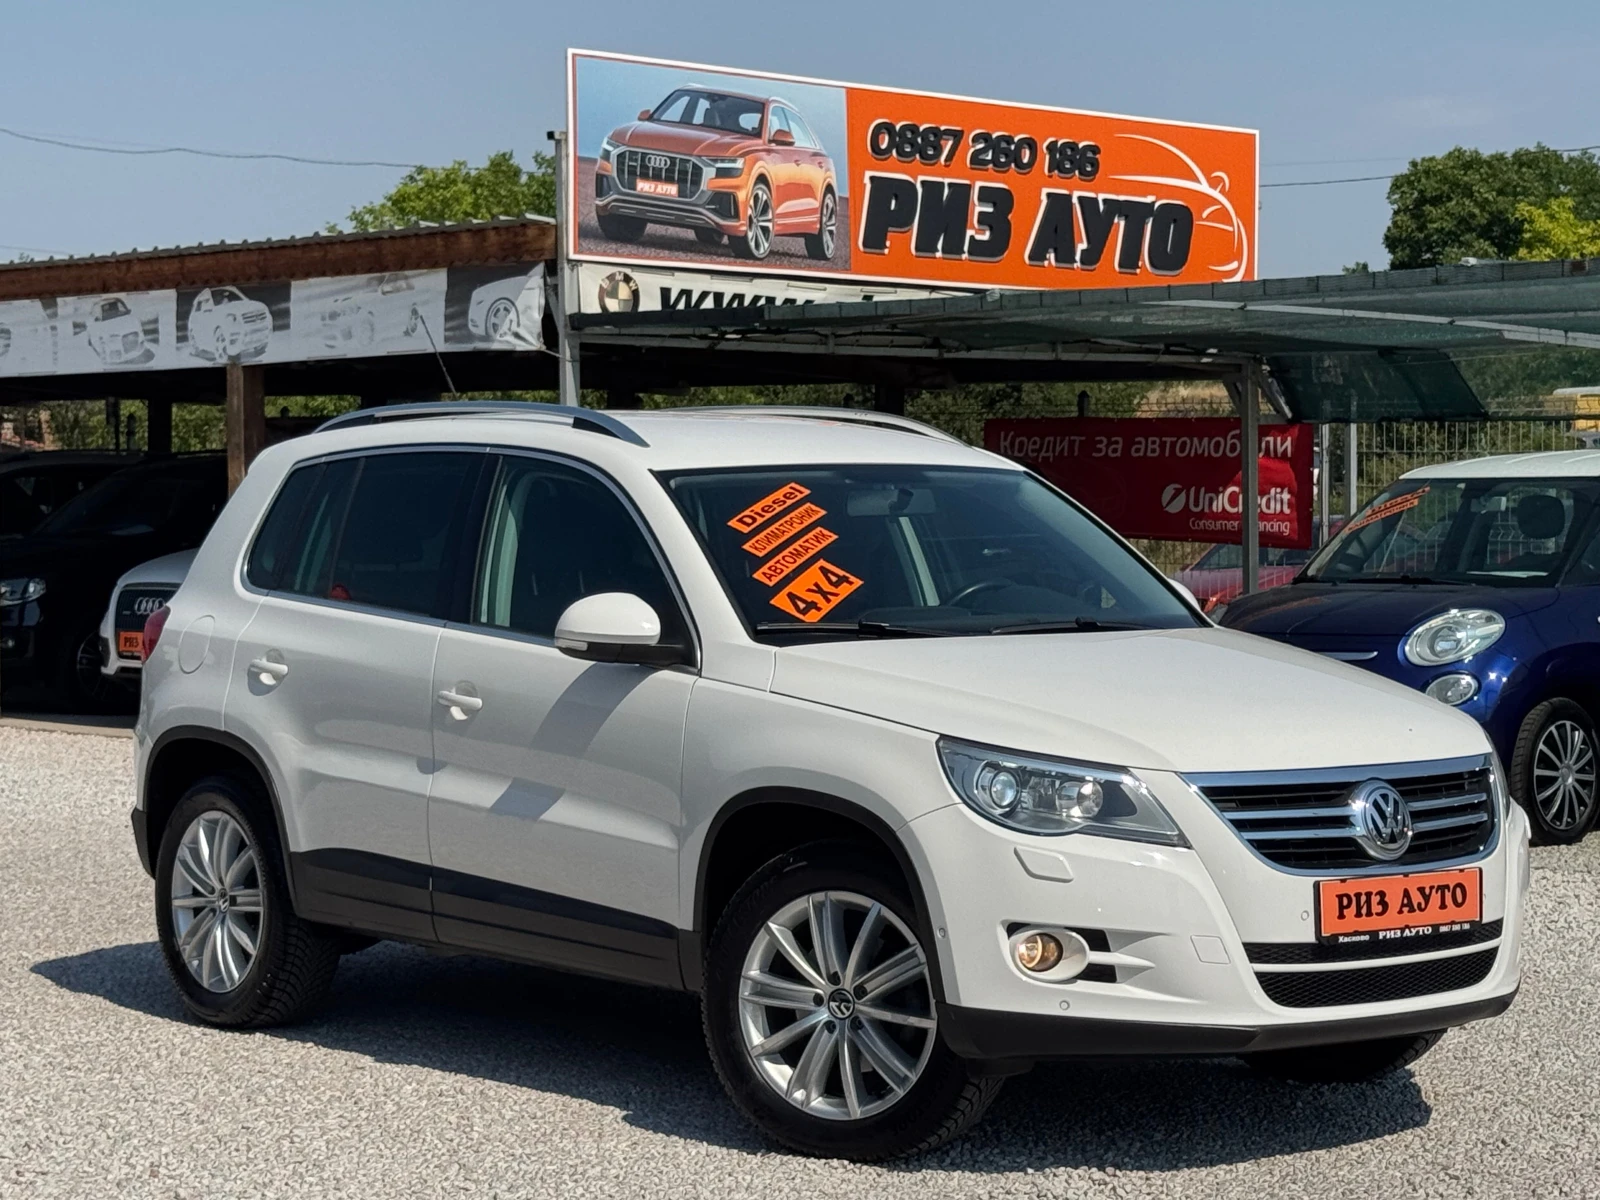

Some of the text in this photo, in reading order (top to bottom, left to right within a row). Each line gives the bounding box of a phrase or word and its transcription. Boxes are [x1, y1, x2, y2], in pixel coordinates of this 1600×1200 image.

[870, 120, 1100, 181] 0887 260 186
[637, 182, 655, 193] РИЗ
[859, 171, 1193, 276] РИЗ АУТО
[1000, 430, 1292, 462] Кредит за автомобли
[736, 486, 804, 528] Diesel
[1189, 517, 1239, 533] Consumer
[749, 505, 821, 553] КЛИМАТРОНИК
[761, 530, 832, 582] АВТОМАТИК
[1335, 882, 1467, 920] РИЗ АУТО
[1338, 934, 1370, 943] Хасково
[1378, 930, 1401, 940] РИЗ
[1403, 926, 1432, 938] АУТО
